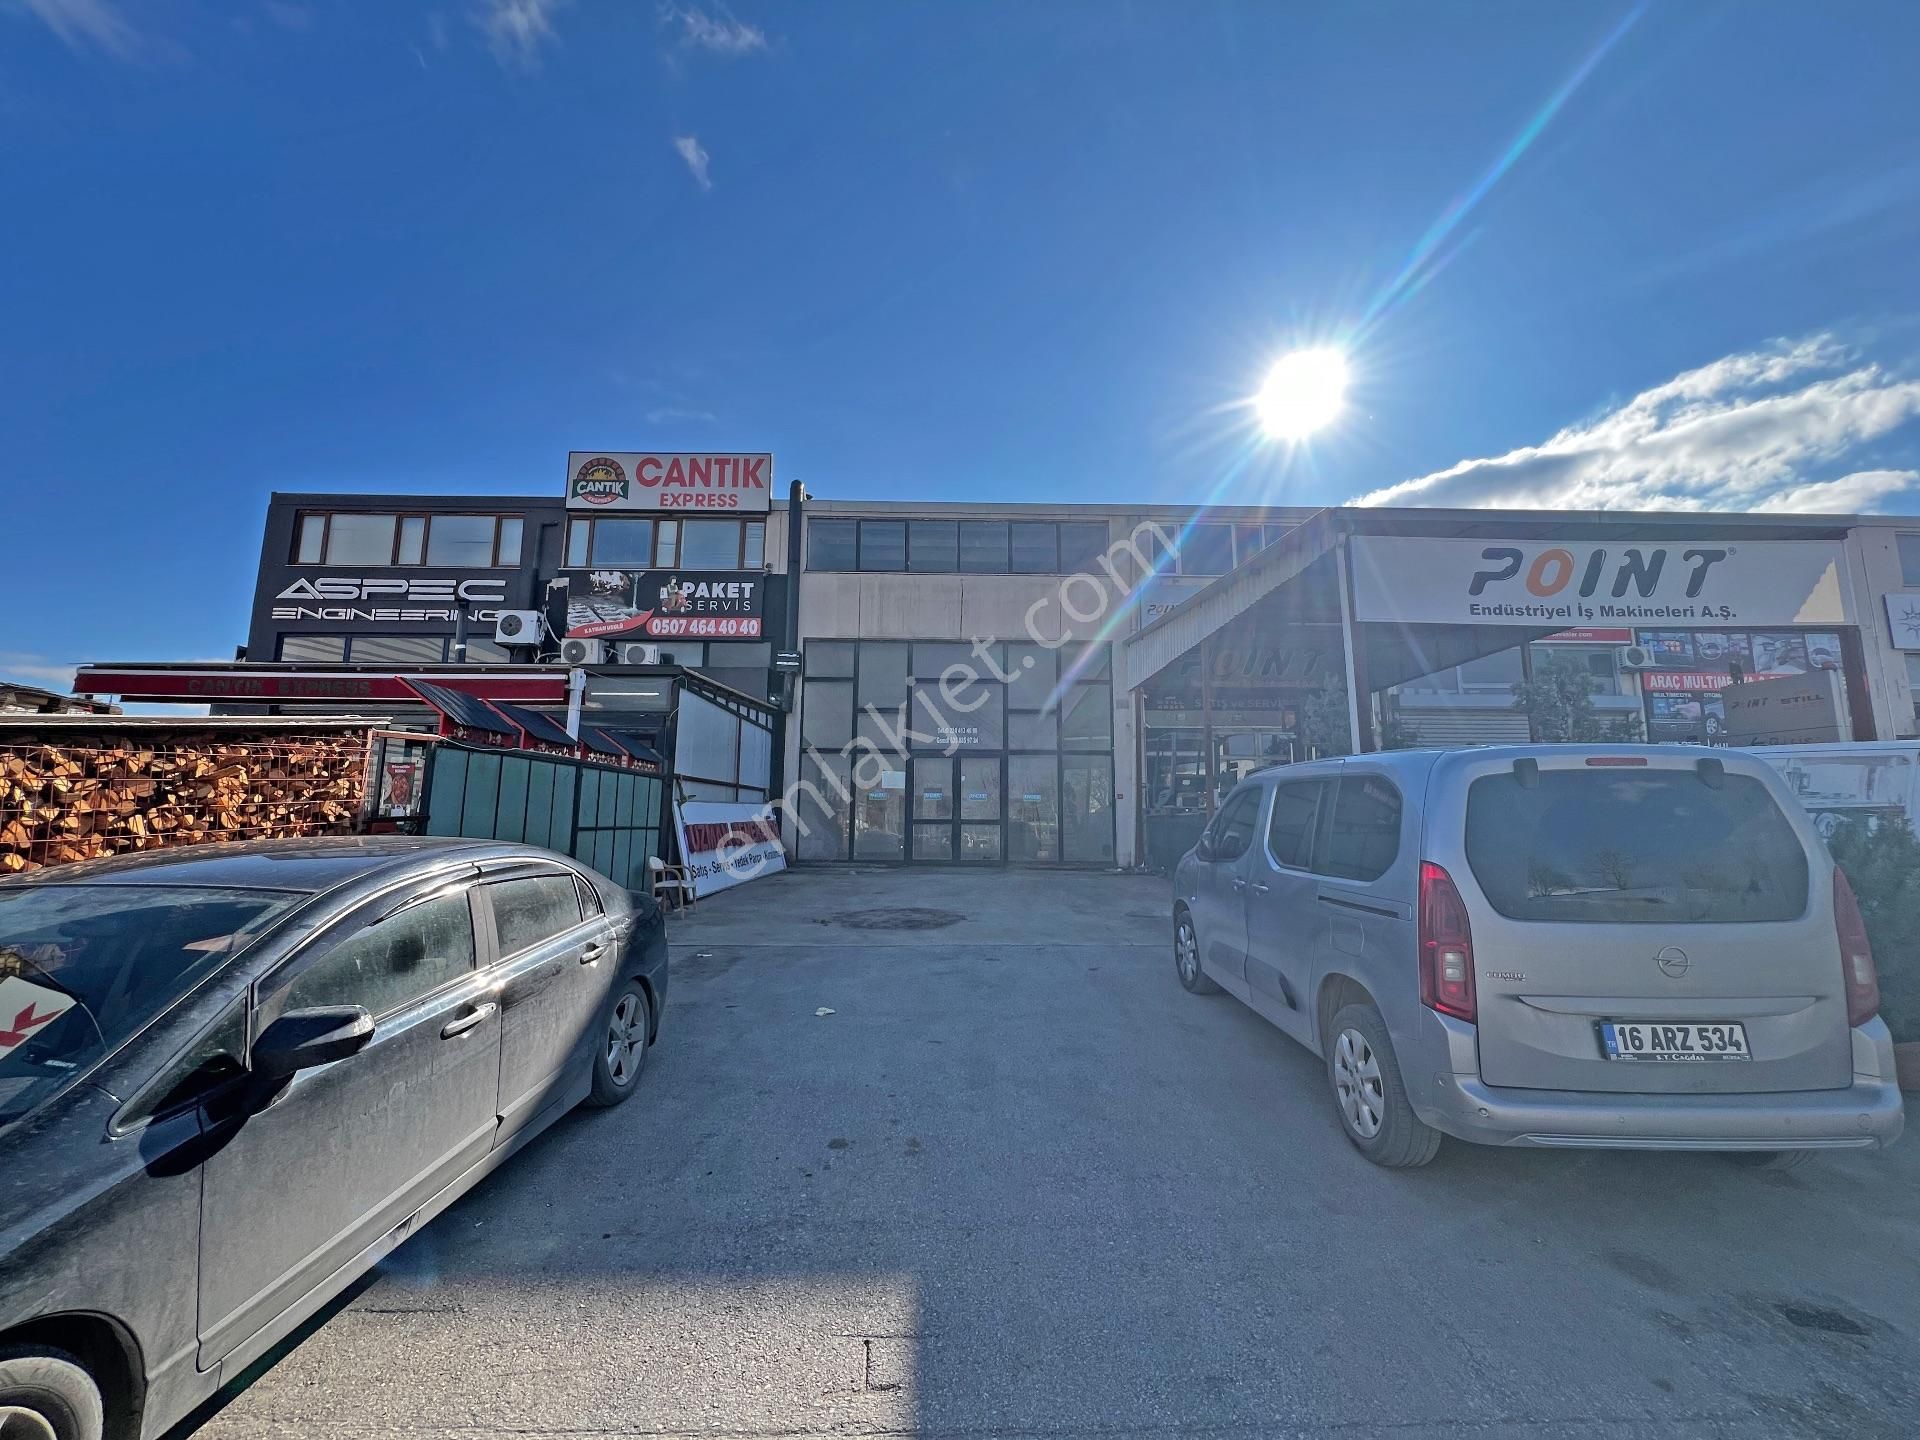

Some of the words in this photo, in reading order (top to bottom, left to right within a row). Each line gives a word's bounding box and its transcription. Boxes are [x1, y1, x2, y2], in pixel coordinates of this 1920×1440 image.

[635, 457, 765, 488] CANTIK
[576, 480, 625, 496] CANTIK
[659, 492, 738, 508] EXPRESS
[1468, 547, 1727, 598] POINT
[275, 577, 507, 601] ASPEC
[683, 582, 755, 598] PAKET
[686, 599, 751, 611] SERVİS
[1469, 603, 1572, 620] Endüstriyel
[1577, 602, 1594, 621] İş
[1599, 604, 1695, 618] Makineleri
[1701, 605, 1738, 621] A.Ş.
[652, 619, 688, 635] 0507
[690, 620, 716, 635] 464
[719, 620, 737, 635] 40
[740, 620, 758, 635] 40
[1650, 675, 1681, 690] ARAÇ
[1618, 1026, 1644, 1051] 16
[1651, 1027, 1695, 1051] ARZ
[1697, 1027, 1743, 1051] 534
